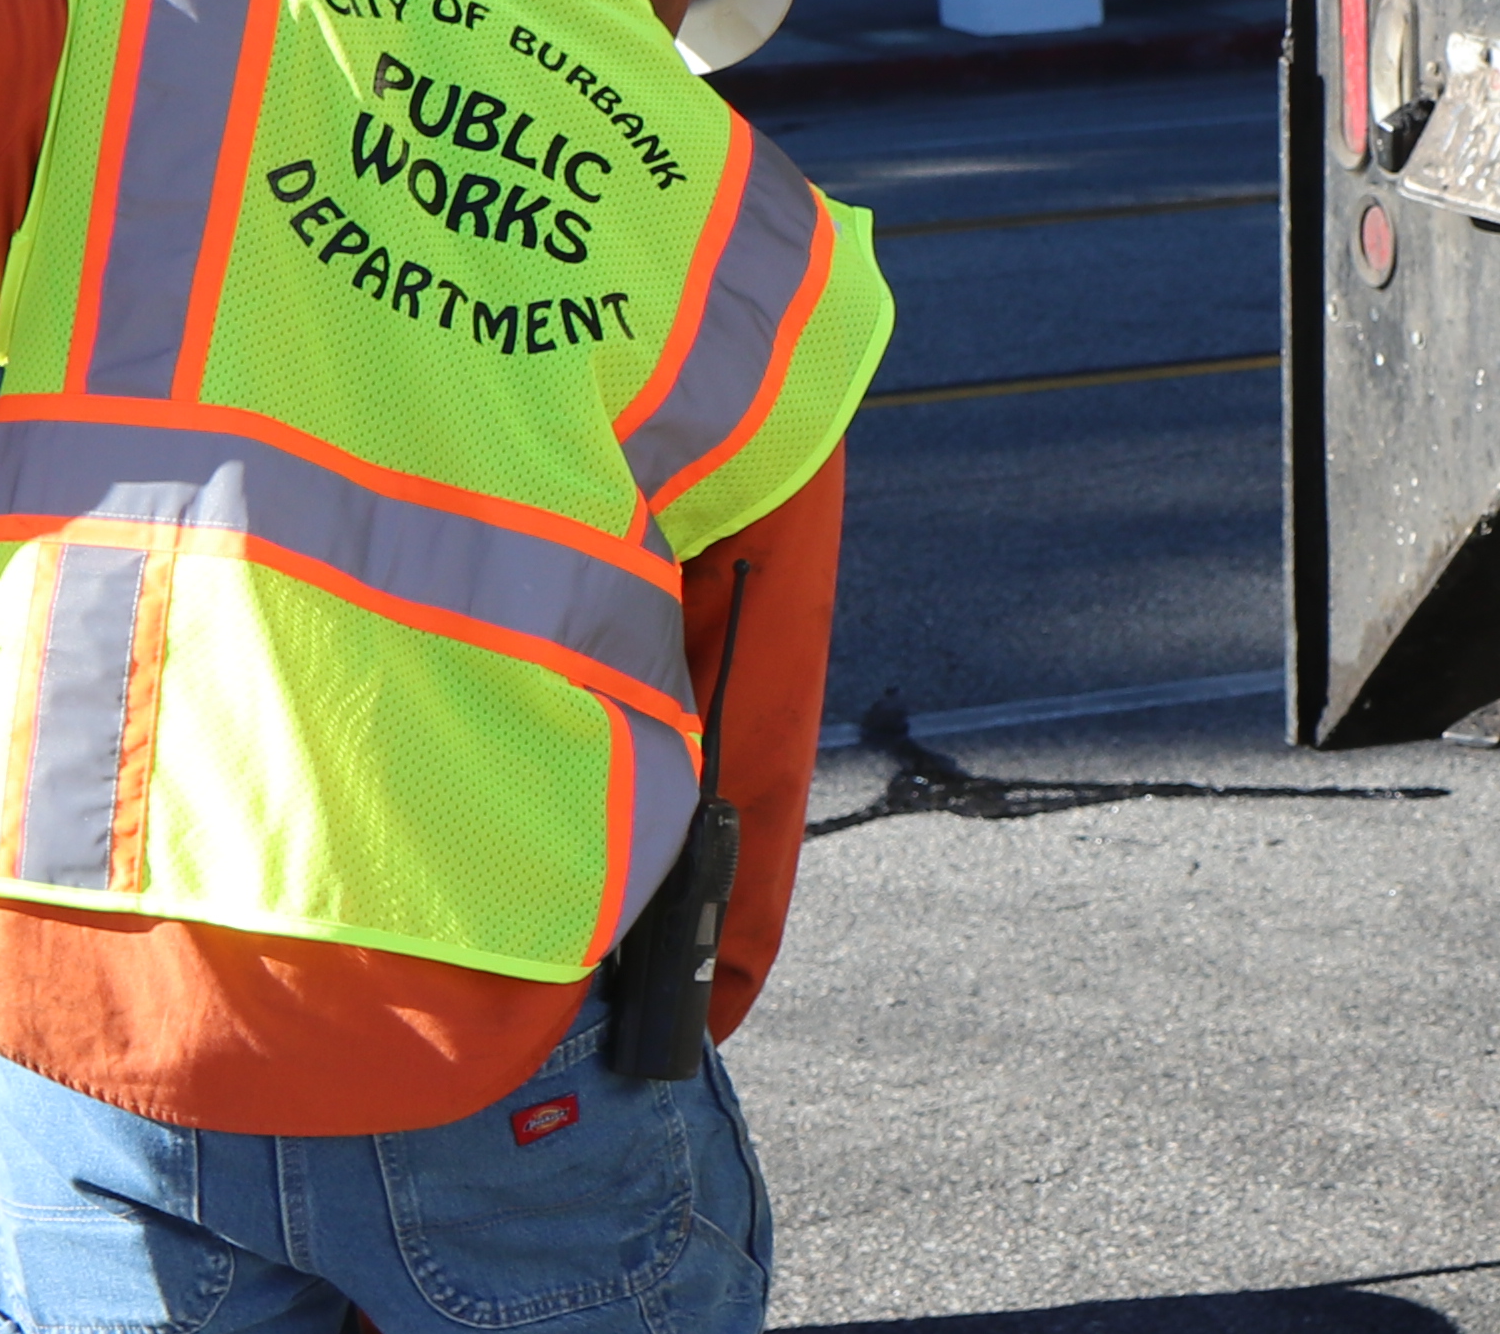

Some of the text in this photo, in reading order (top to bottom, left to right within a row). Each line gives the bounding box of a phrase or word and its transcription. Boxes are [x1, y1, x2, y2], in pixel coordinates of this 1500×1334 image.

[373, 51, 612, 204] PUBLIC
[508, 24, 687, 190] BURBANK
[266, 159, 635, 355] DEPARTMENT
[352, 112, 592, 264] WORKS
